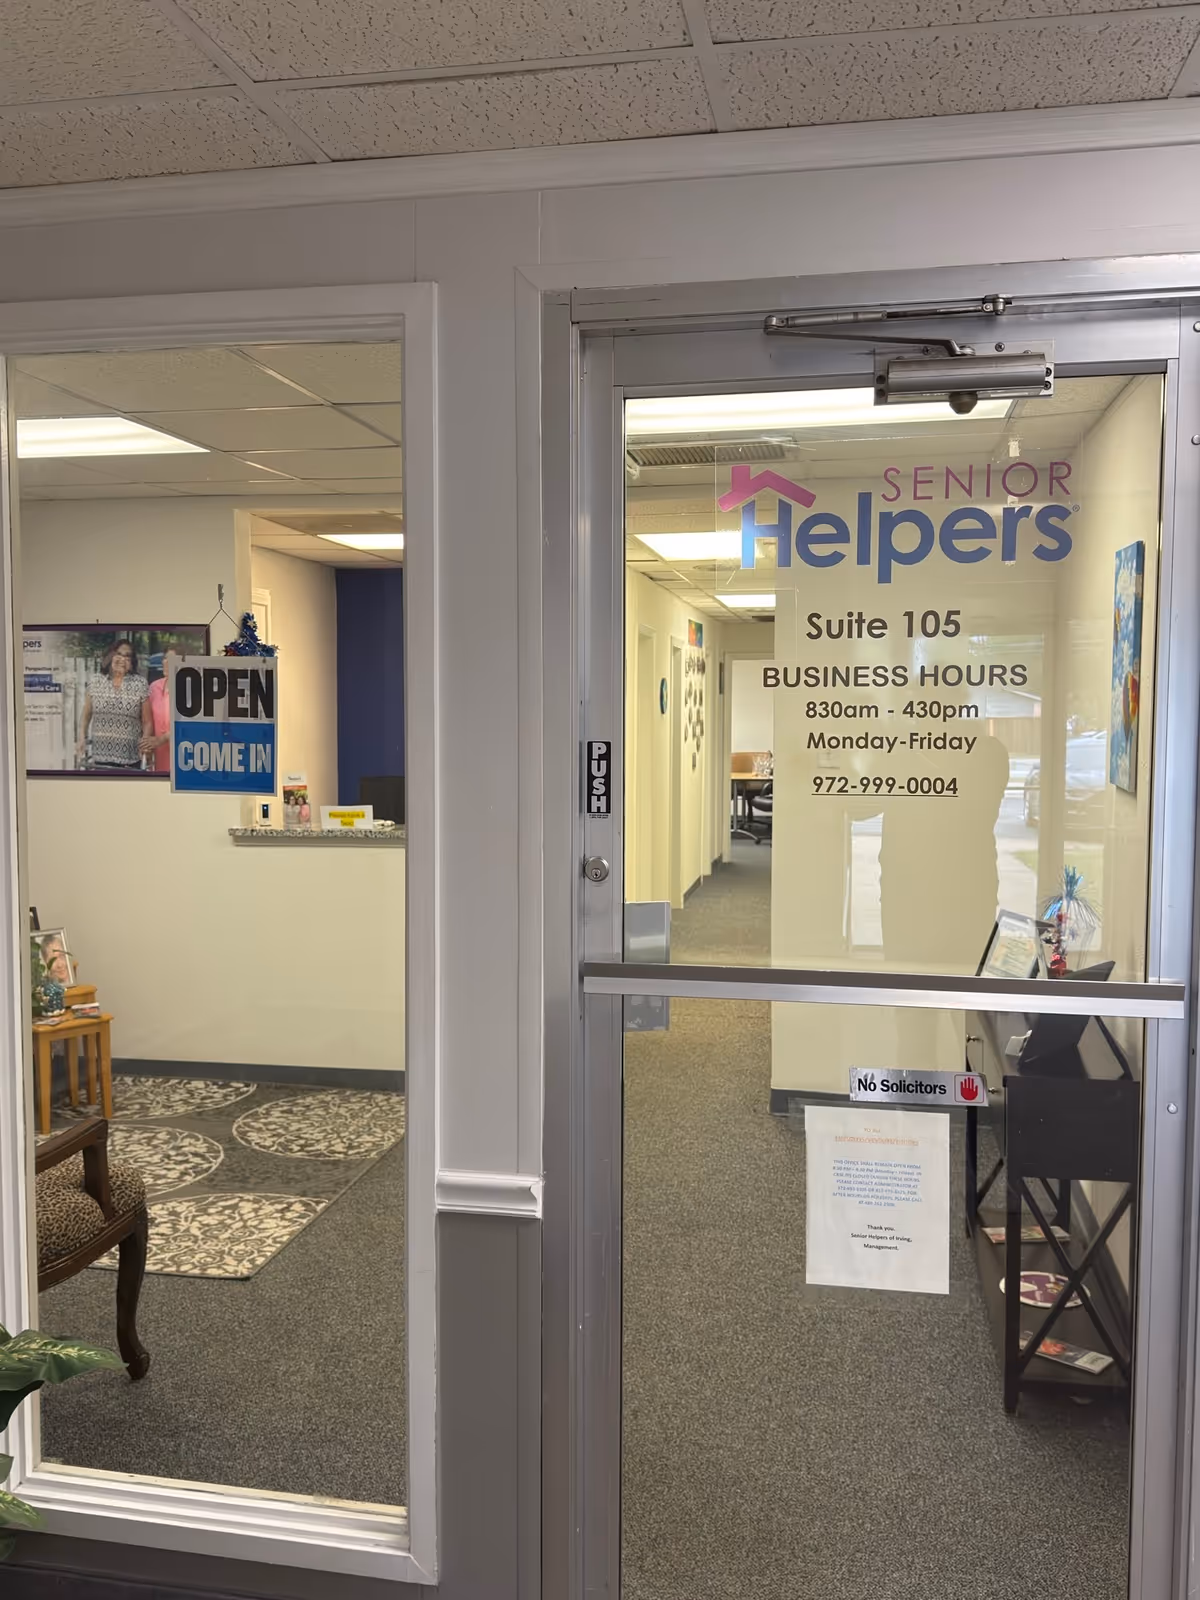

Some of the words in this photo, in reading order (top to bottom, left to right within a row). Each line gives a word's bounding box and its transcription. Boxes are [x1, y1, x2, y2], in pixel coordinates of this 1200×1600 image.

[880, 461, 1073, 502] SENIOR
[741, 491, 1073, 584] Helpers
[805, 611, 888, 639] Suite
[902, 610, 961, 638] 105
[762, 665, 909, 688] BUSINESS
[919, 664, 1028, 687] HOURS
[175, 666, 274, 719] OPEN
[805, 701, 879, 718] 830am
[902, 701, 979, 722] 430pm
[178, 741, 245, 772] COME
[249, 743, 272, 773] IN
[806, 732, 978, 753] Monday-Friday
[590, 742, 607, 813] PUSH
[812, 776, 959, 796] 972-999-0004
[857, 1078, 877, 1092] No
[880, 1079, 947, 1095] Solicitors
